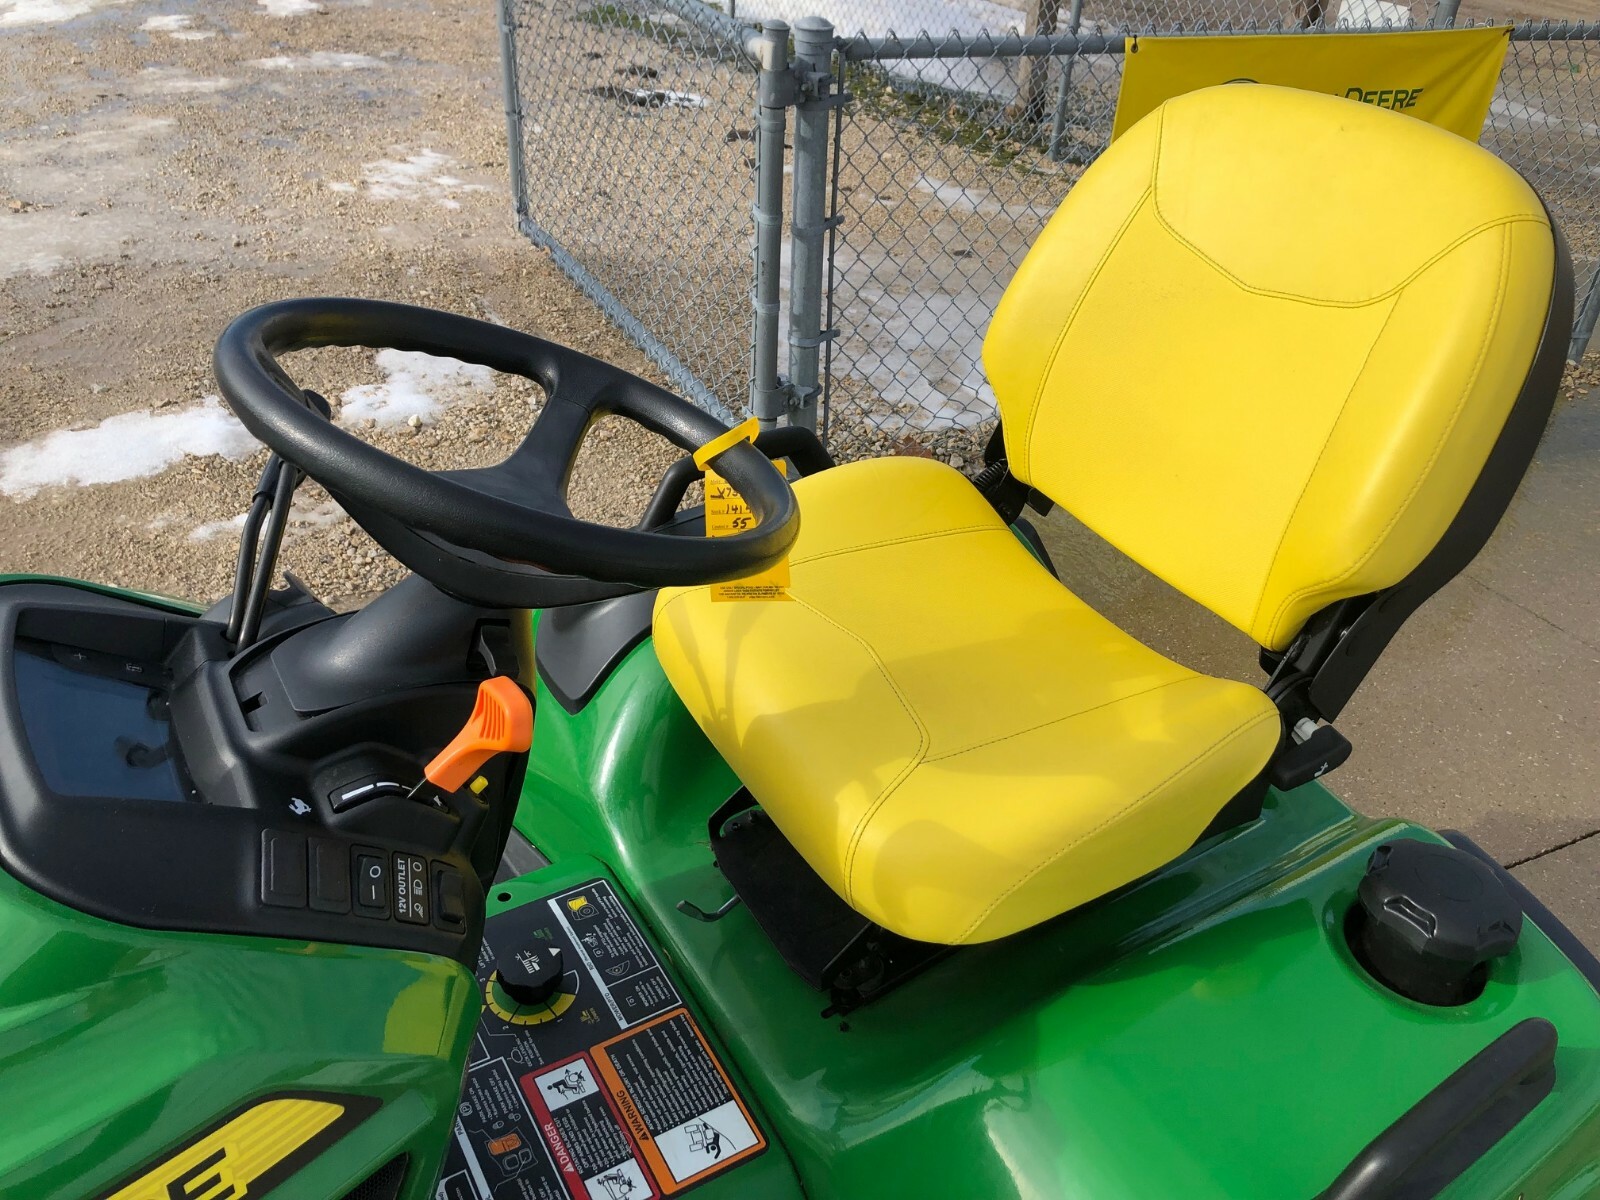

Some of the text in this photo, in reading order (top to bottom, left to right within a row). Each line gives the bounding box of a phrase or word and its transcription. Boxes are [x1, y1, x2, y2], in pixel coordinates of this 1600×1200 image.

[1345, 88, 1424, 110] DEERE
[732, 517, 752, 528] 55
[397, 858, 406, 895] OUTLET
[610, 1053, 654, 1130] AVOID SERIOUS INJURY OR DEATH
[615, 1089, 644, 1134] WARNING
[543, 1122, 569, 1164] DANGER
[553, 1116, 583, 1174] ROTATING BLADES CUT
[561, 1116, 589, 1168] OFF ARMS AND LEGS
